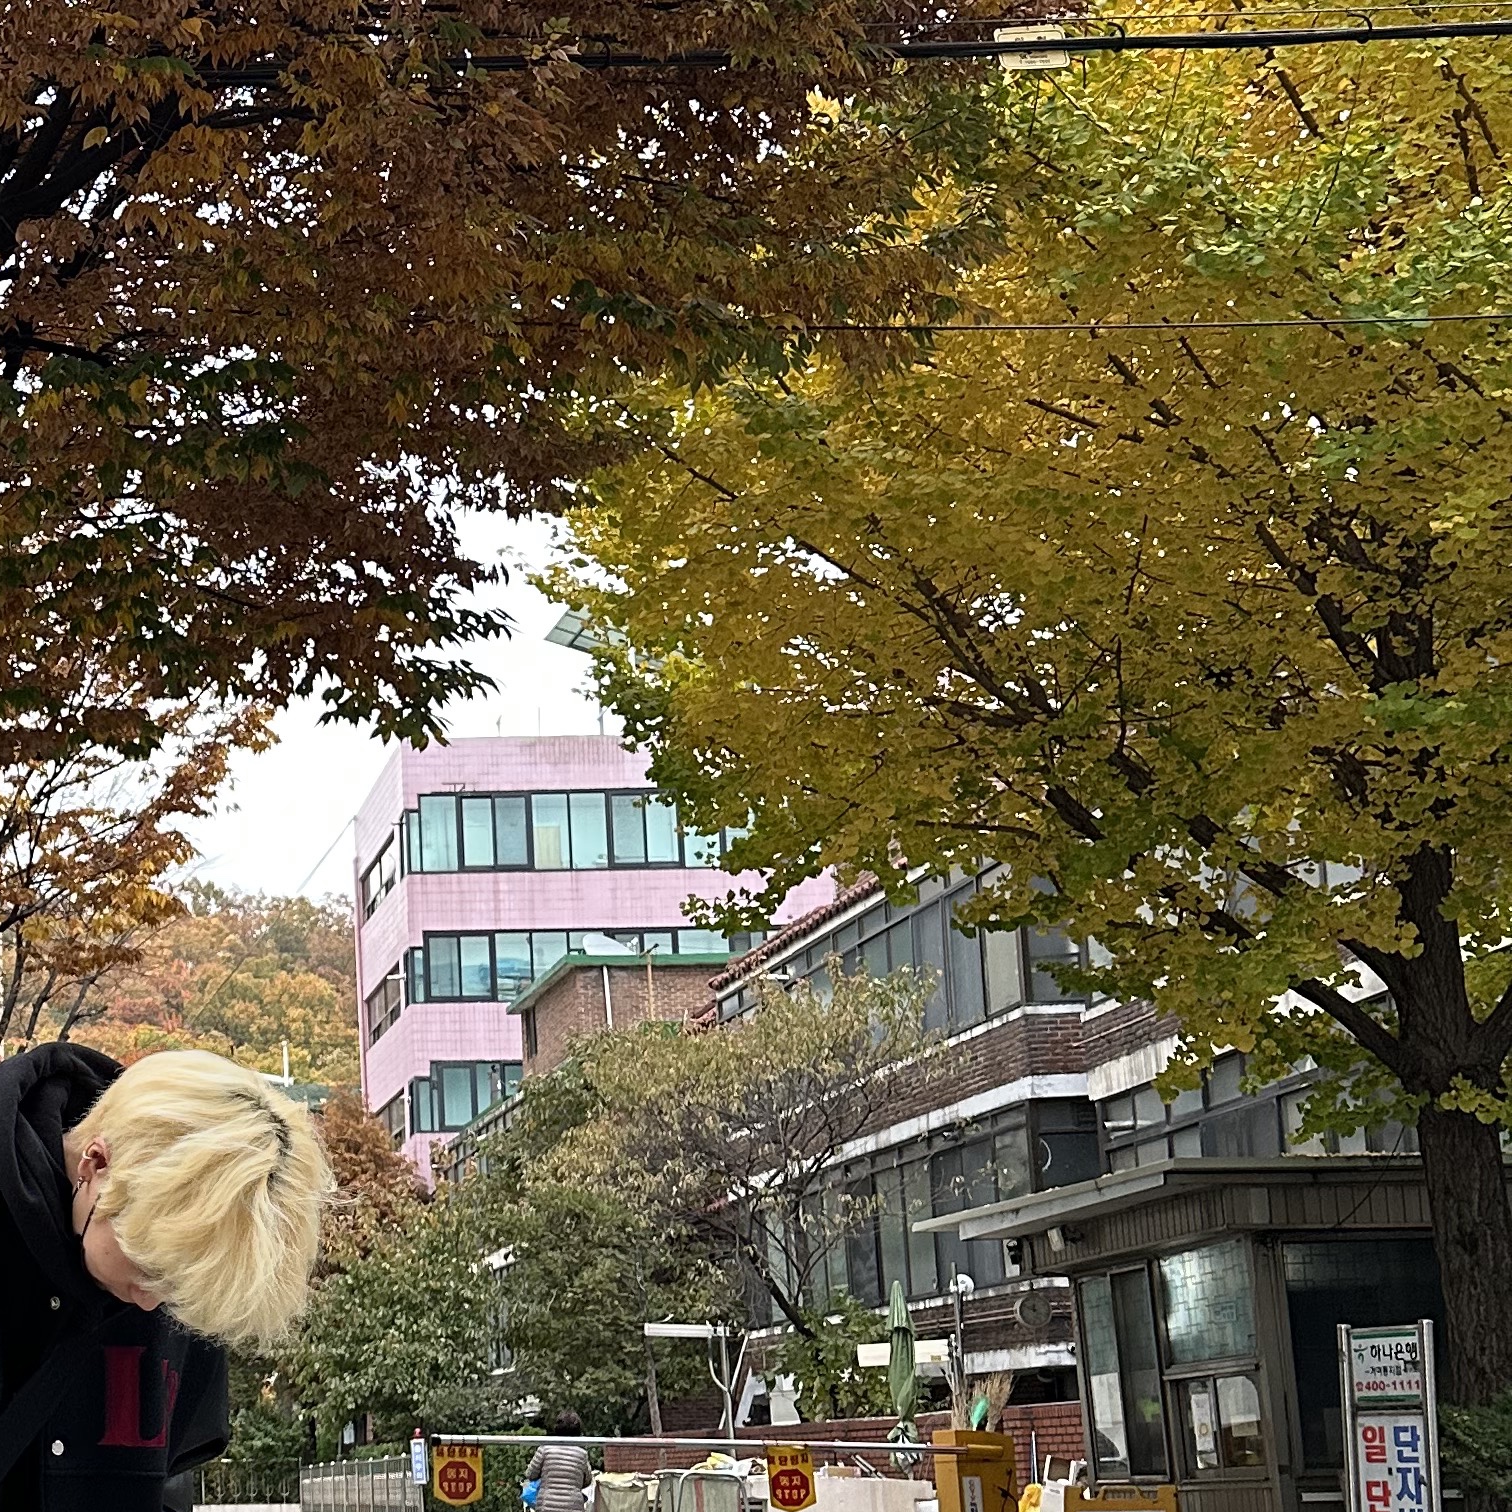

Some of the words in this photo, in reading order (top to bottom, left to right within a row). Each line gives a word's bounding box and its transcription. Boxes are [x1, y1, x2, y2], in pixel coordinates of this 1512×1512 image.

[1369, 1341, 1418, 1361] 하나은행
[1364, 1379, 1421, 1391] 400-1111
[442, 1481, 473, 1493] STOP
[775, 1488, 807, 1500] STOP
